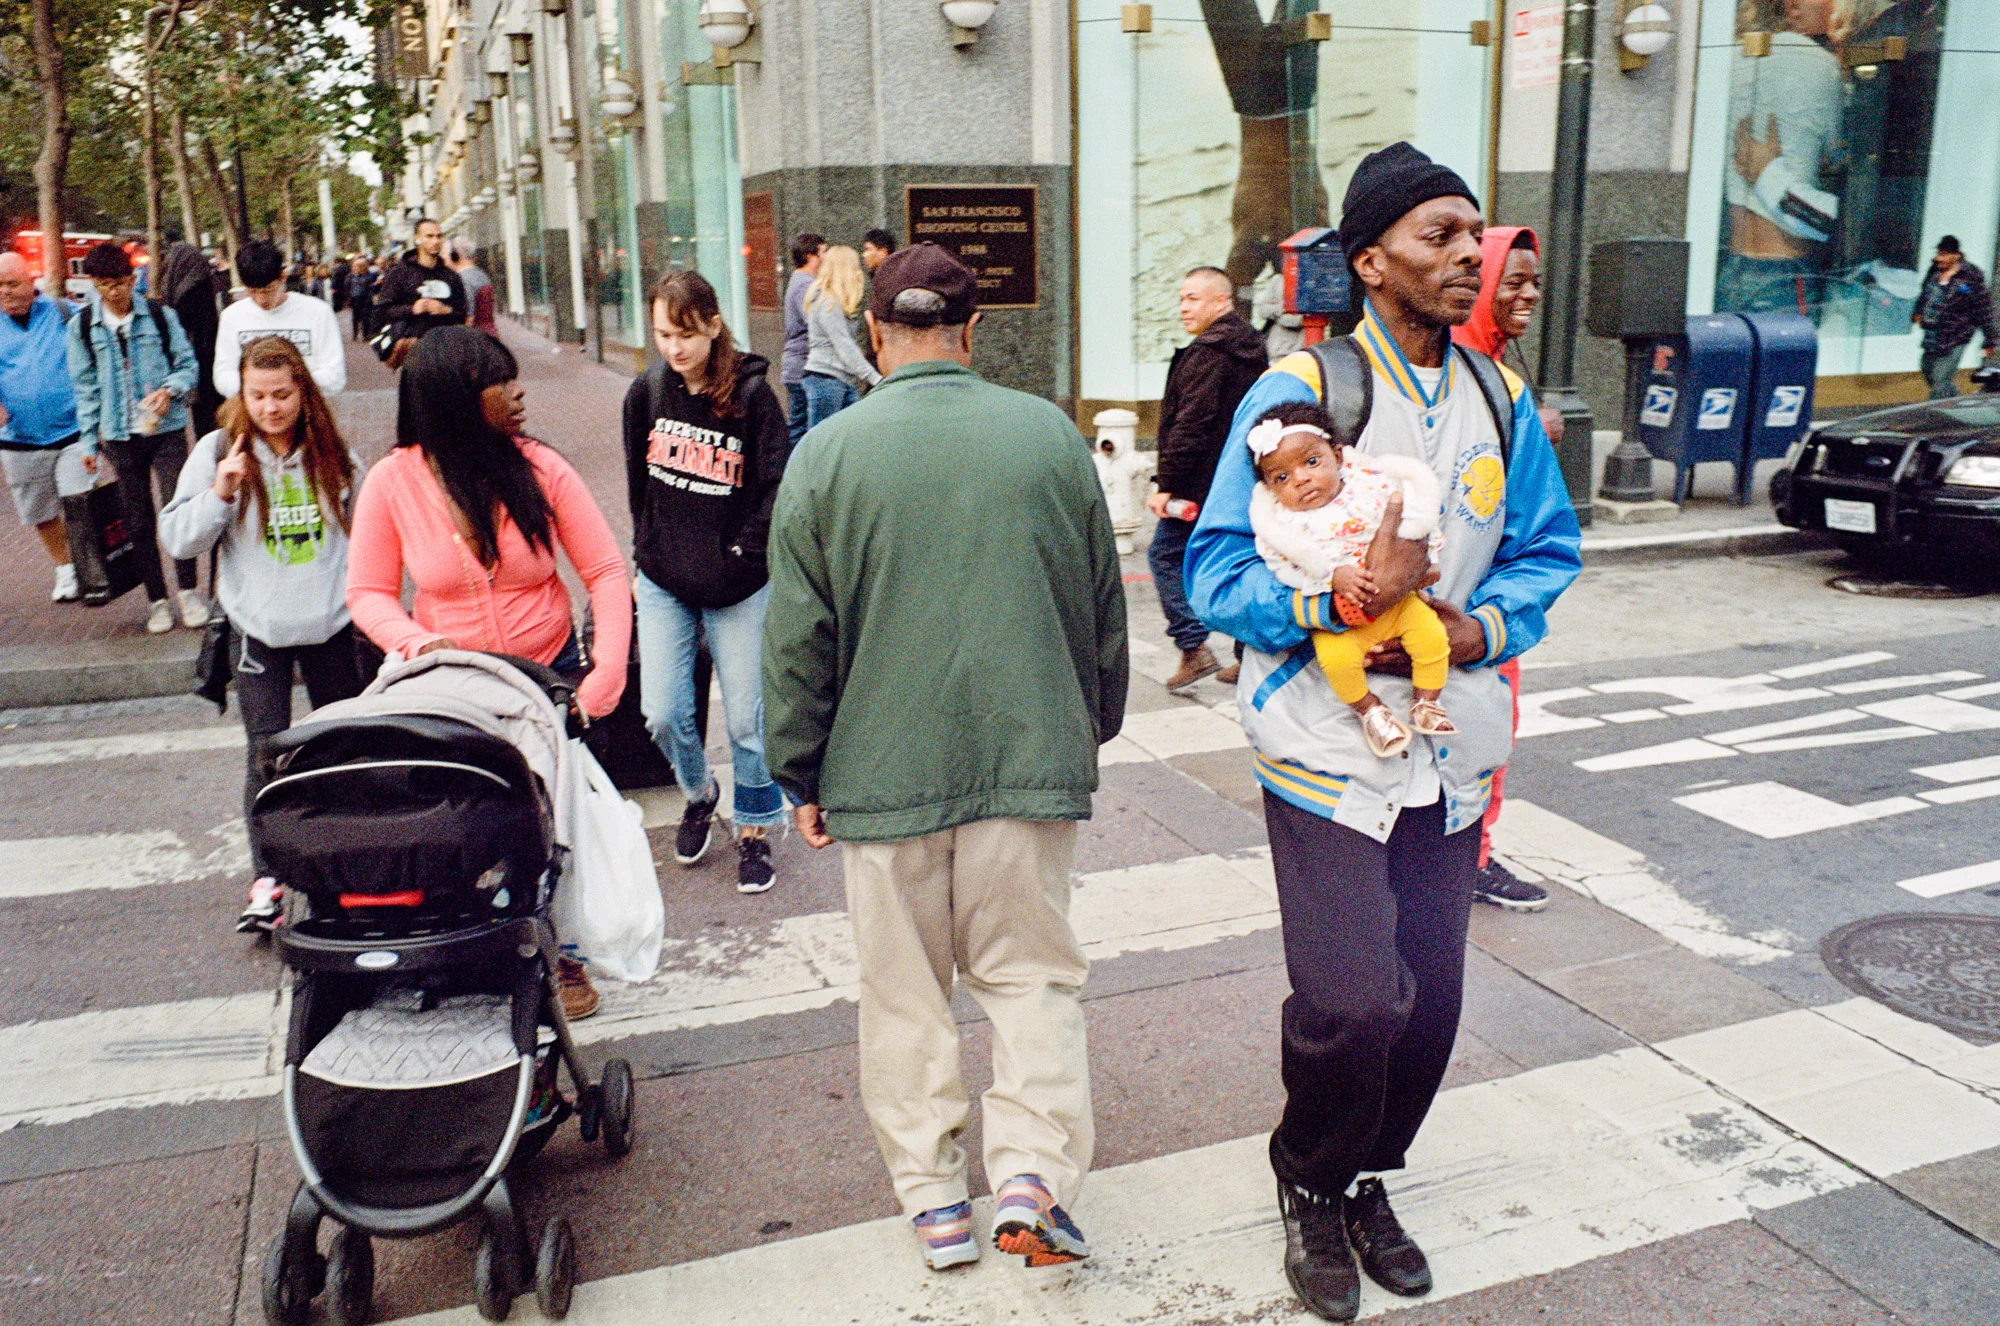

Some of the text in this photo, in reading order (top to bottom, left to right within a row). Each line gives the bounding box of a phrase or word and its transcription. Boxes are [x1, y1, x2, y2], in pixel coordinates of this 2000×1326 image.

[922, 206, 1021, 217] SAN FRANCISCO
[915, 222, 978, 233] SHOPPING
